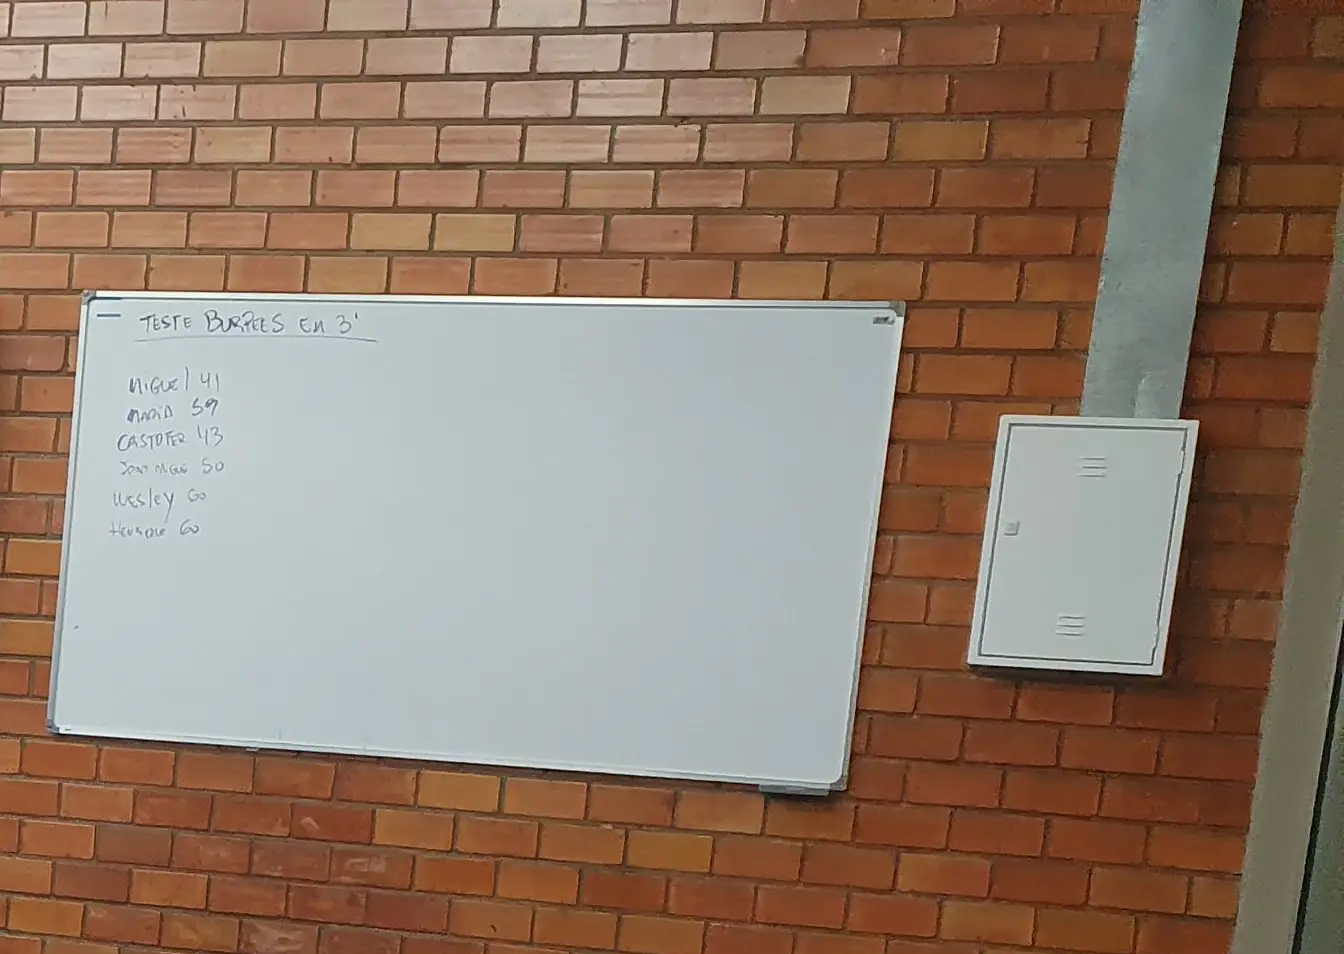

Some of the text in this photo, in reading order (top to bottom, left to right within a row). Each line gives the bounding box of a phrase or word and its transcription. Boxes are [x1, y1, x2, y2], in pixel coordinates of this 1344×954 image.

[139, 313, 192, 332] TESTE
[203, 309, 285, 334] BURPEES
[200, 371, 220, 393] 41
[192, 397, 219, 417] 59
[196, 424, 224, 448] 43
